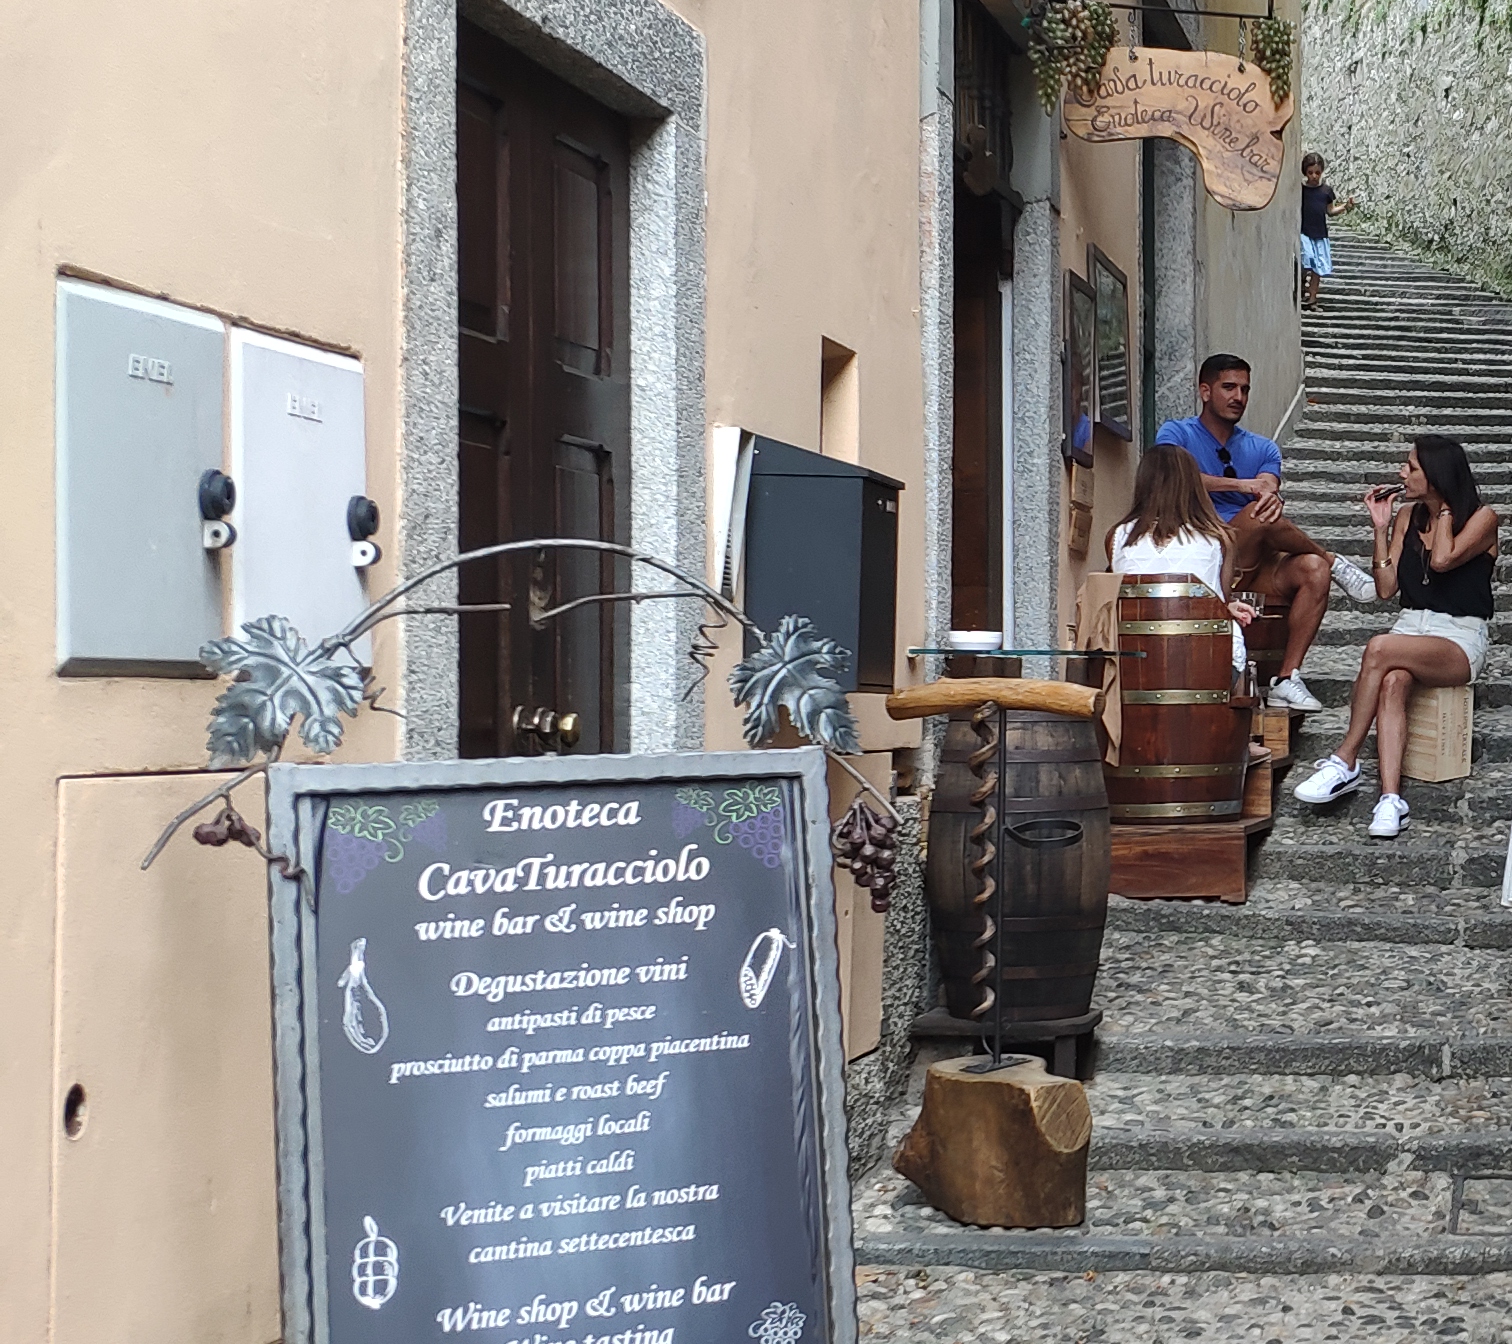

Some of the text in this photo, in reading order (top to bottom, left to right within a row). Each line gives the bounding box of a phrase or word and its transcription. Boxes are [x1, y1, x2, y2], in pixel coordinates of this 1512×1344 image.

[1090, 95, 1272, 173] Enoteca Wine bar
[128, 353, 173, 385] ENEL
[482, 798, 642, 833] Enoteca
[417, 843, 711, 901] CavaTuracciolo
[413, 896, 716, 941] wine bar & wine shop
[449, 955, 689, 1003] Degustazione vini
[485, 1002, 657, 1035] antipasti di pesce
[388, 1030, 751, 1085] prosciutto di parma coppa piacentina
[483, 1070, 670, 1108] salumi e roast beef
[498, 1110, 652, 1152] formaggi locali
[523, 1149, 636, 1187] piatti caldi
[440, 1183, 720, 1227] Venite a visitare la nostra
[468, 1224, 697, 1264] cantina settecentesca
[436, 1275, 737, 1333] Wine shop & wine bar
